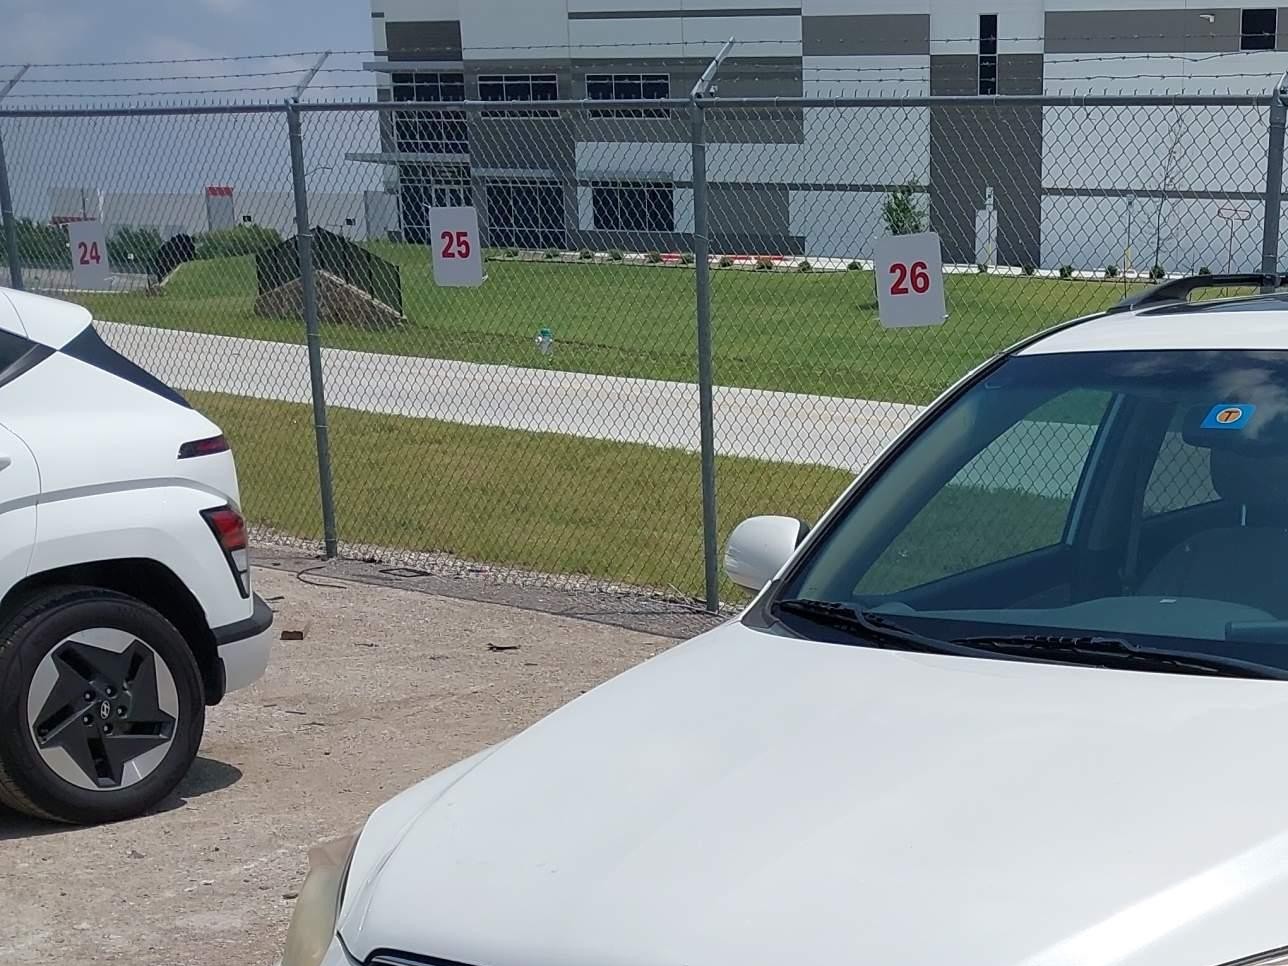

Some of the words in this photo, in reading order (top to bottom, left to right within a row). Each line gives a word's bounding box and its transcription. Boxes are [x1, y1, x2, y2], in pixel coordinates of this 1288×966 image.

[78, 241, 101, 265] 24
[440, 230, 471, 259] 25
[888, 261, 930, 296] 26
